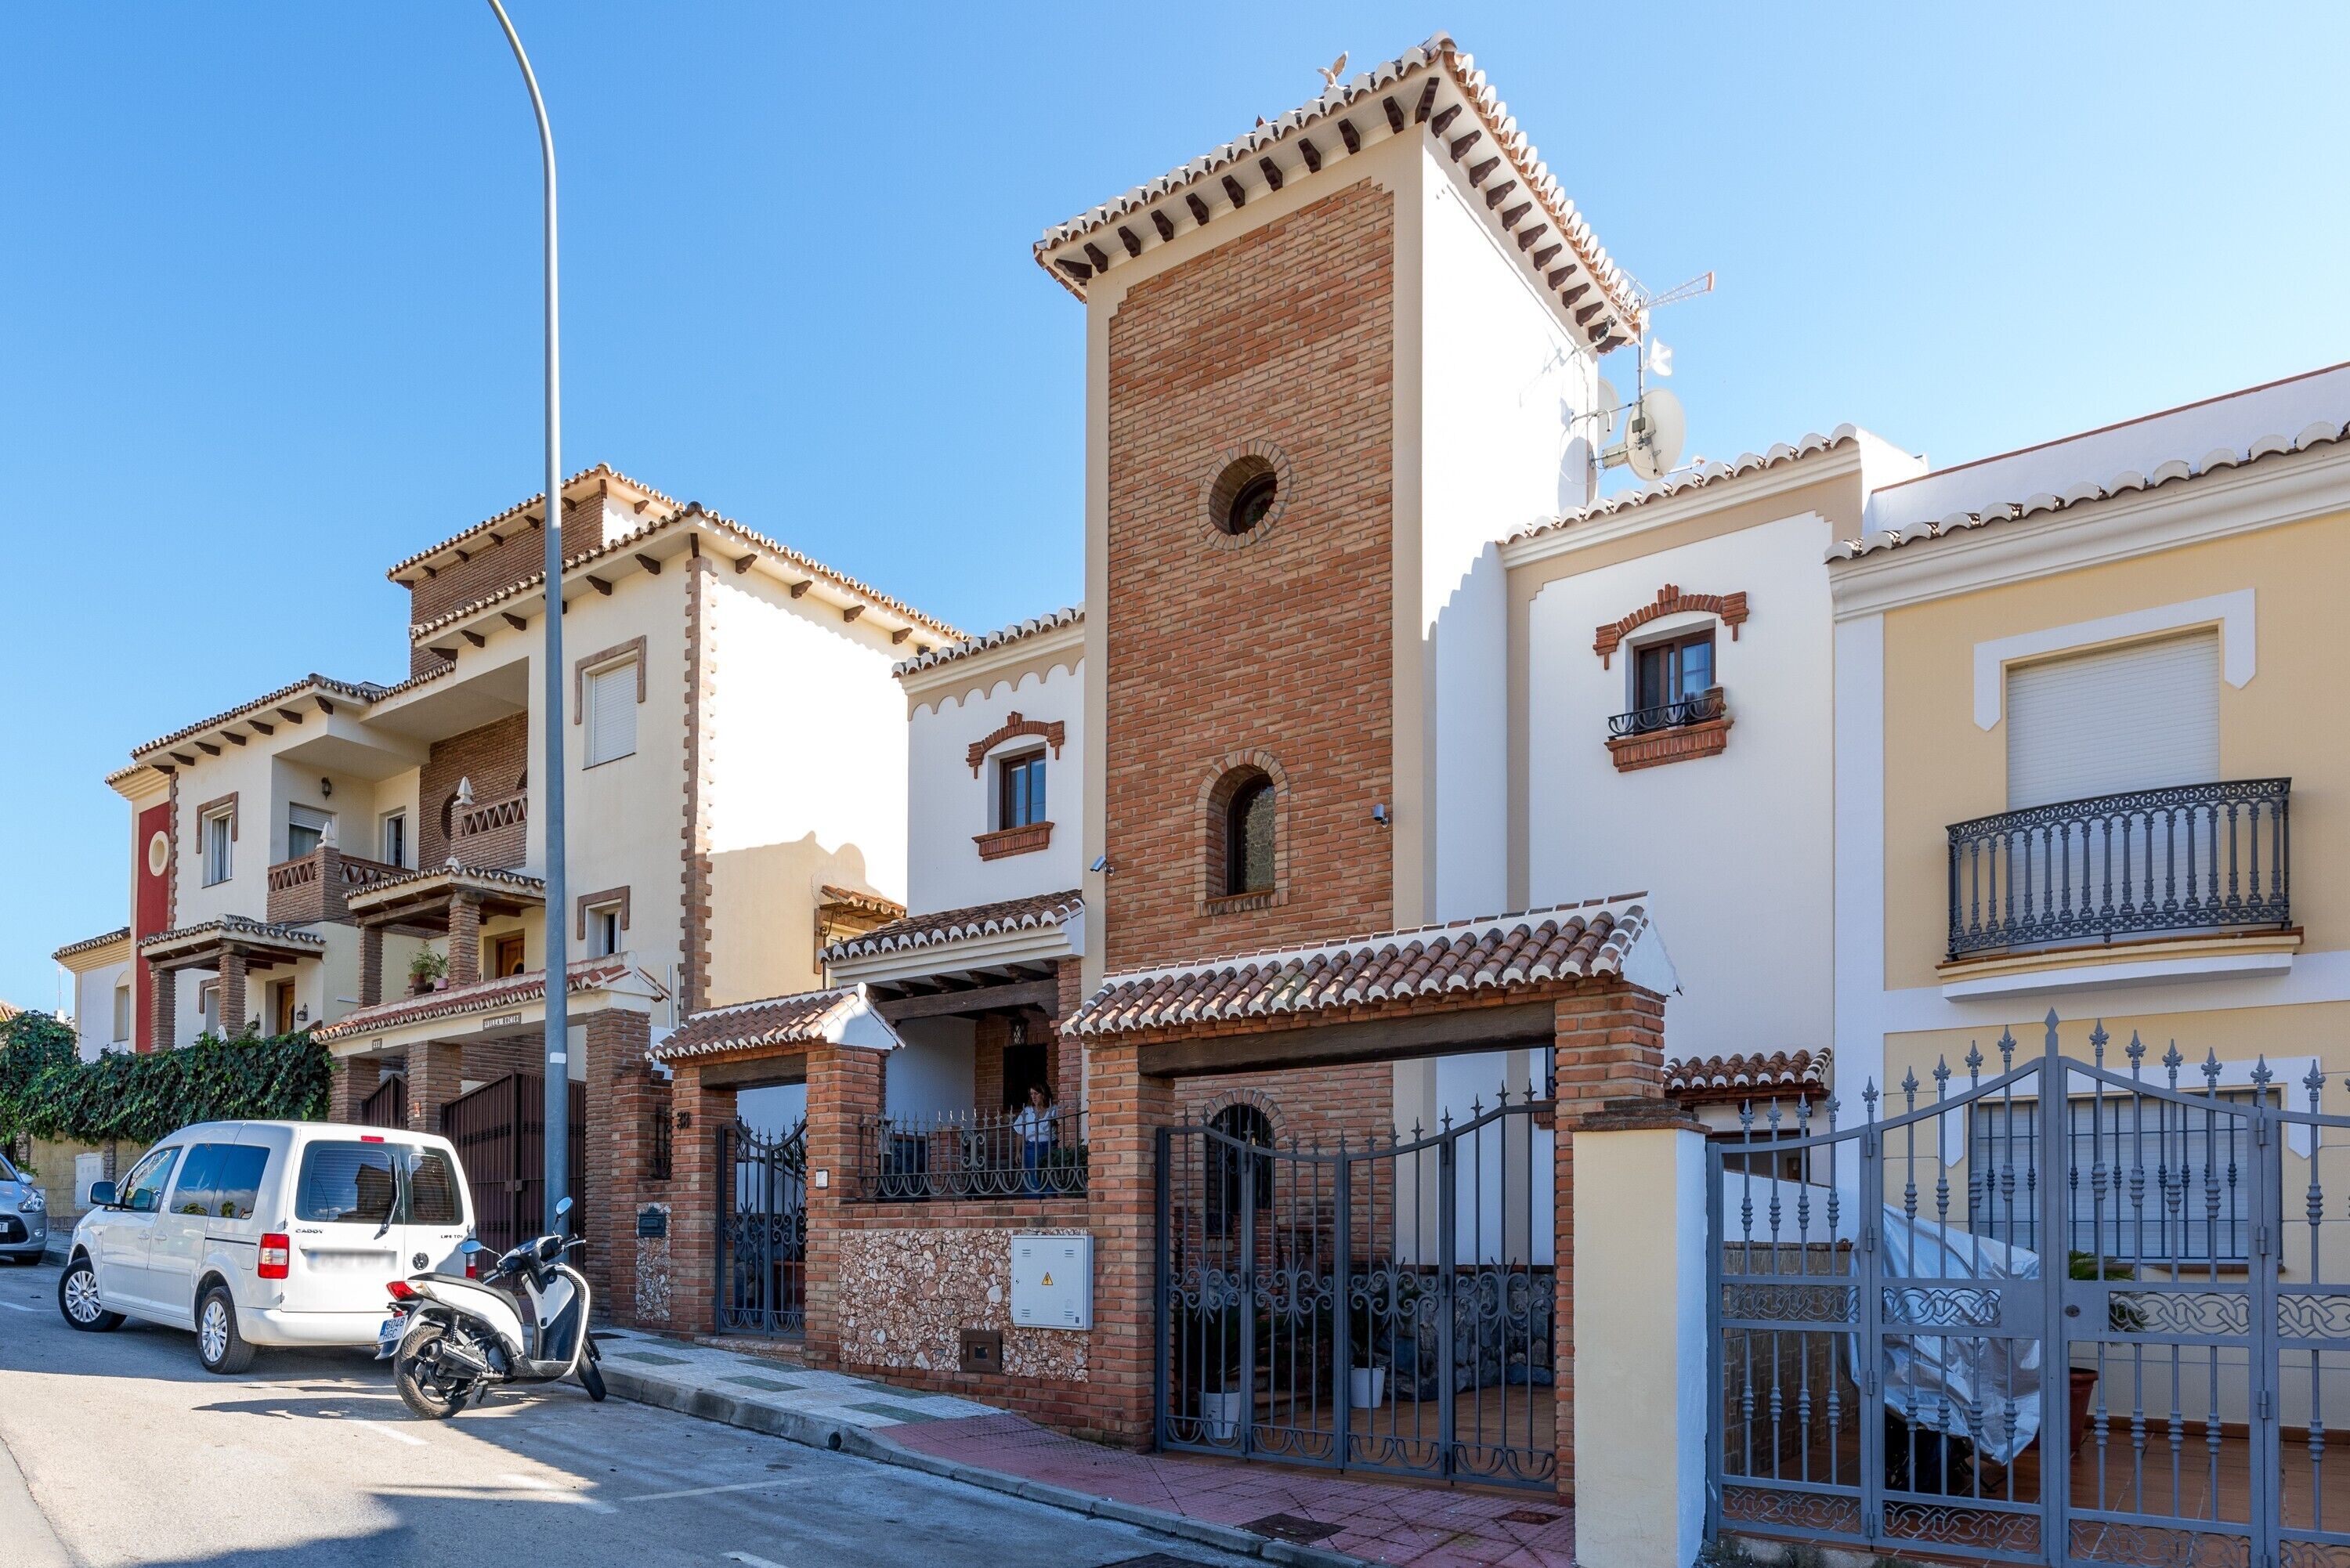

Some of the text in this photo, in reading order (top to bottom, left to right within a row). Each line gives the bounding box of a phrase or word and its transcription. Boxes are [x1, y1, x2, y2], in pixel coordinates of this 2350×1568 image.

[676, 1111, 690, 1129] 38
[385, 1317, 406, 1330] 6048
[382, 1328, 398, 1340] HGC
